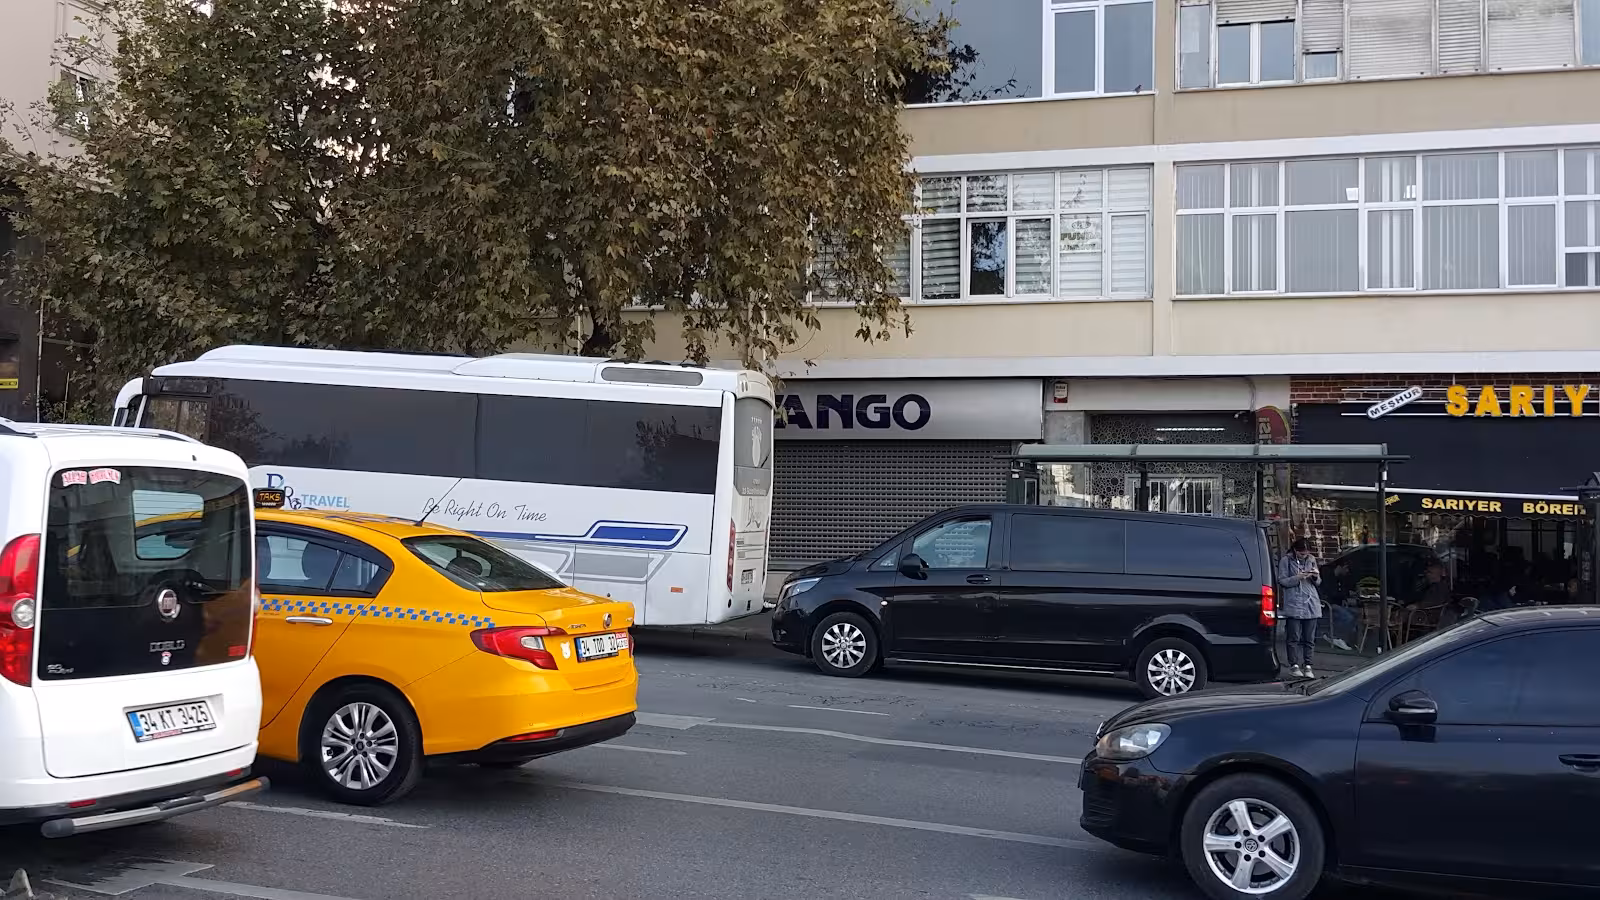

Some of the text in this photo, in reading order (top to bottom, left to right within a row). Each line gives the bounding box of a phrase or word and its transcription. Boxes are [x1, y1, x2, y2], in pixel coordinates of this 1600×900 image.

[1445, 383, 1600, 418] SARIY
[301, 494, 350, 508] TRAVEL
[444, 499, 484, 521] Right
[486, 502, 507, 519] On
[514, 504, 547, 521] Time
[1421, 498, 1502, 513] SARIYER
[139, 712, 159, 732] 34
[158, 710, 176, 729] KT
